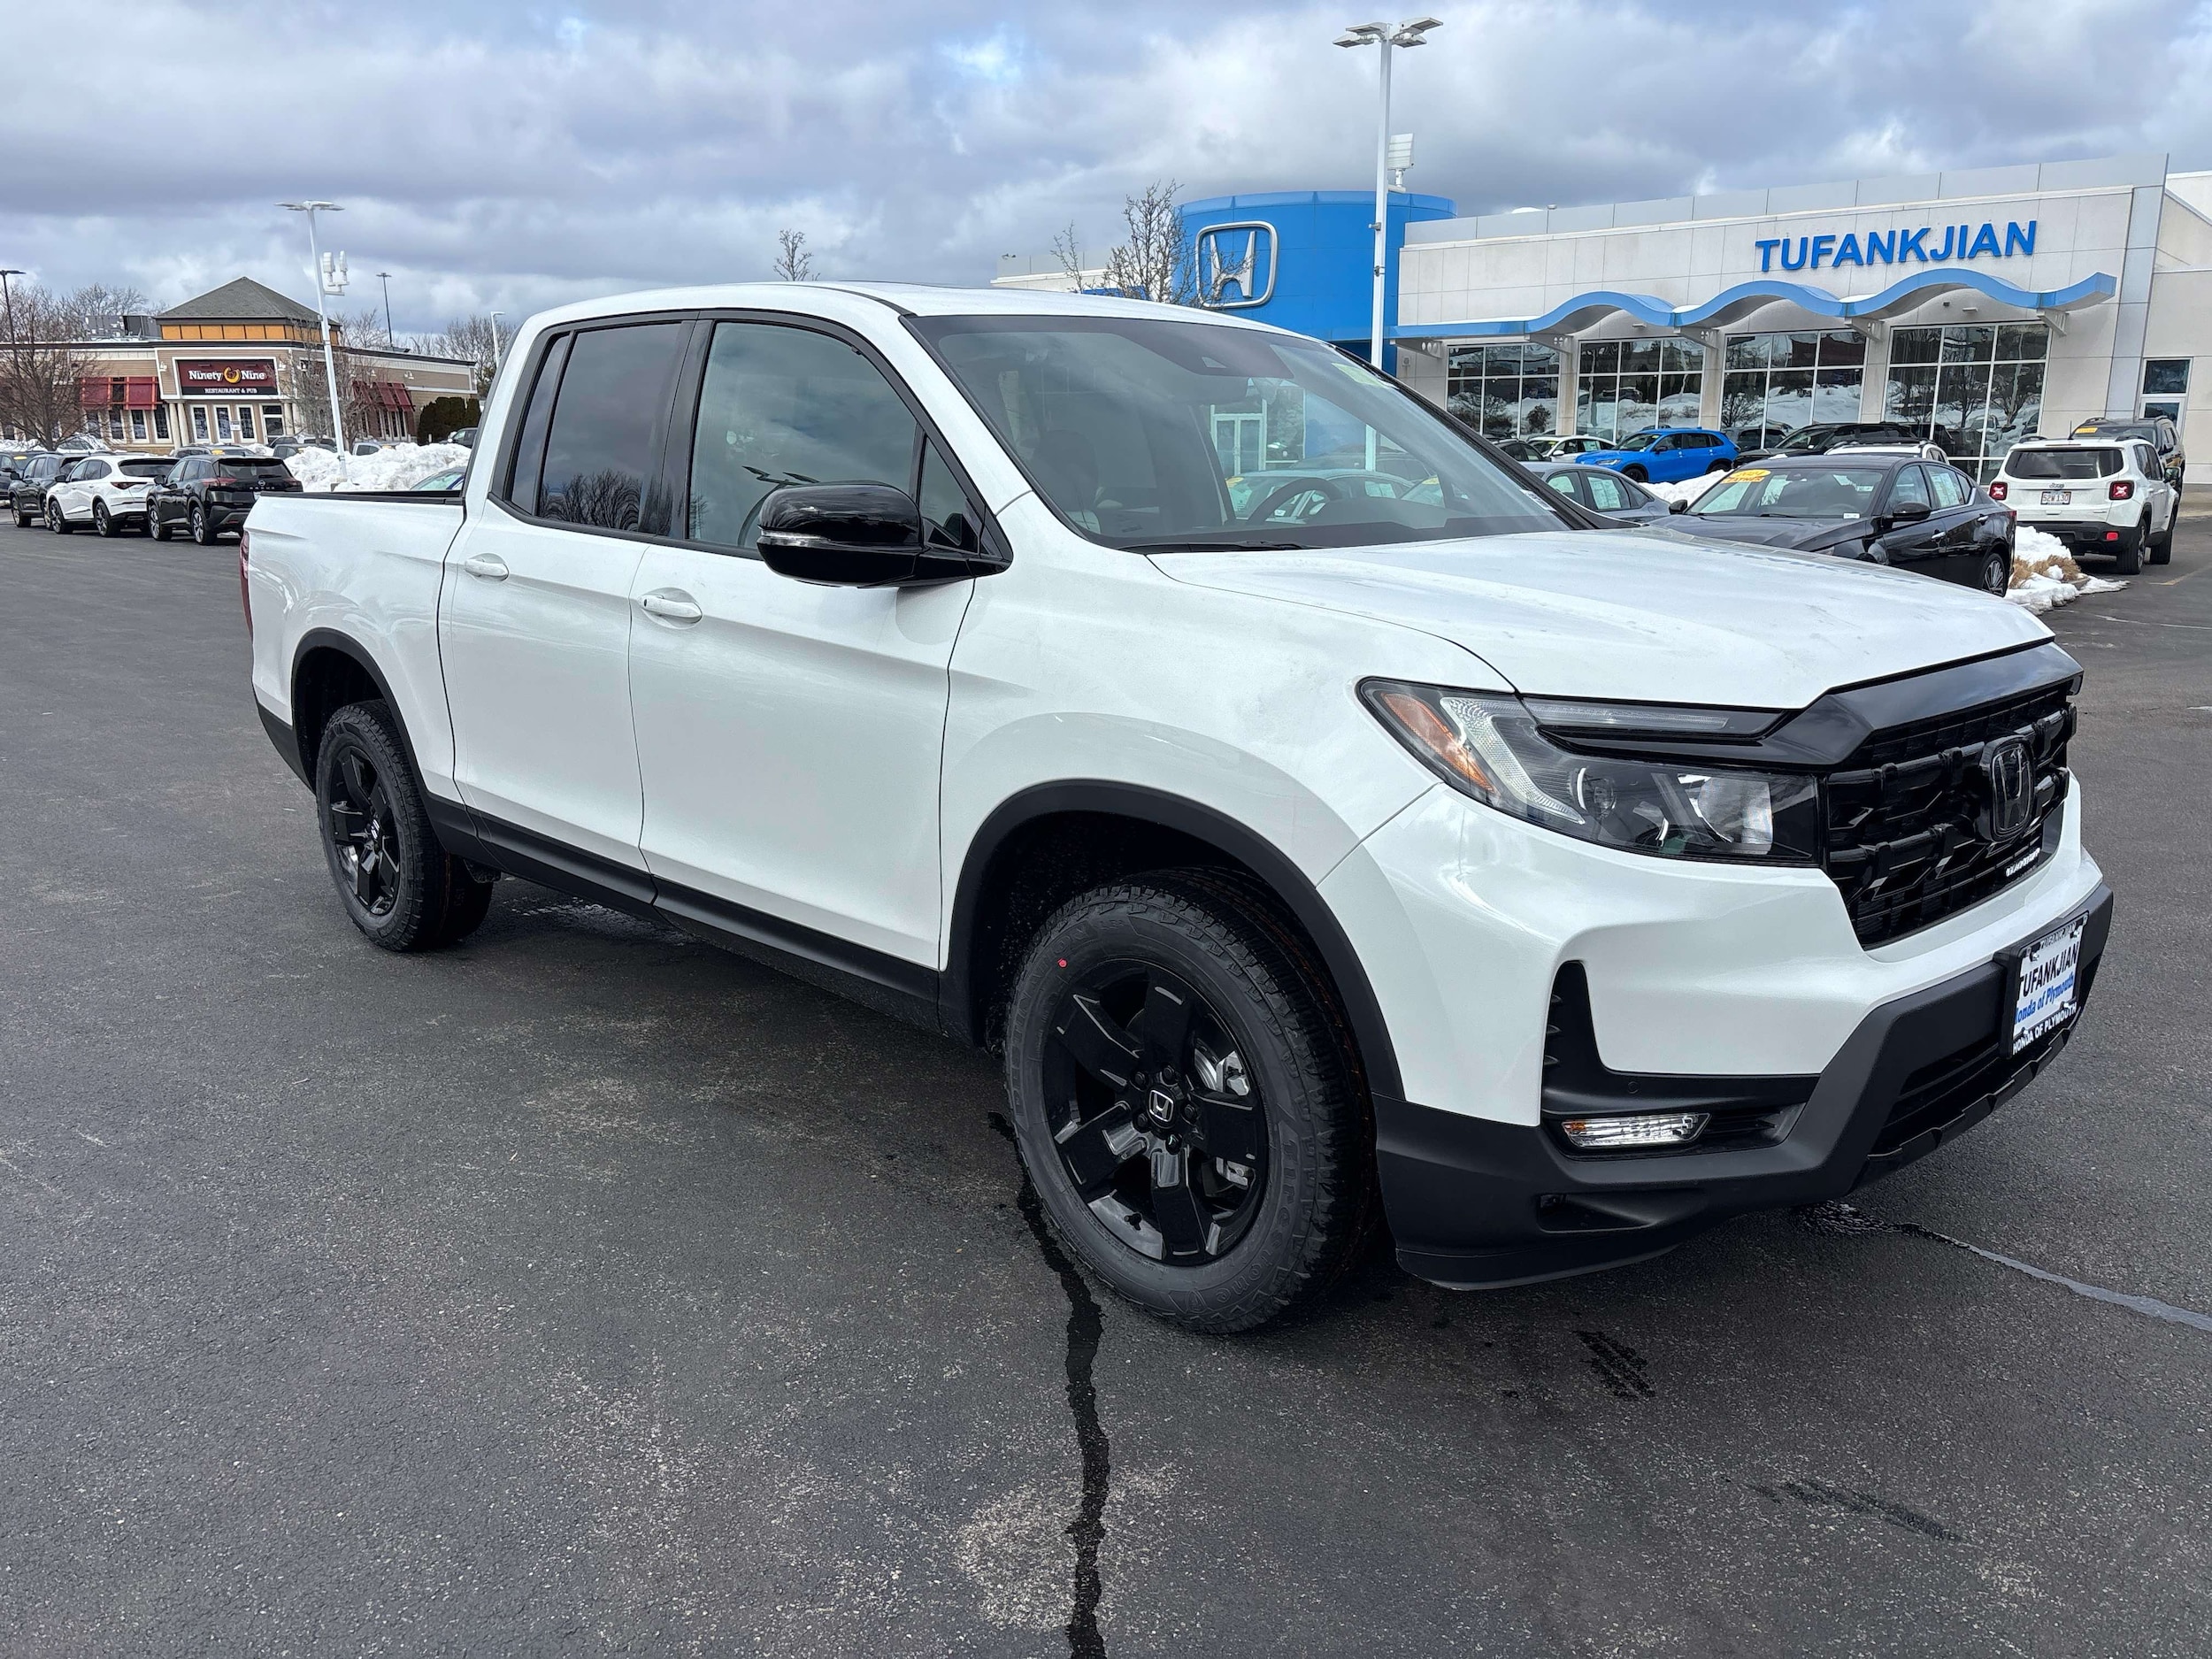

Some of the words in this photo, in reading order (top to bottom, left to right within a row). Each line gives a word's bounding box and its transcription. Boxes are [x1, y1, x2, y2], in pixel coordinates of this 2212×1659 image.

[1755, 219, 2037, 273] TUFANKJIAN
[188, 370, 223, 381] Ninety
[240, 370, 266, 380] Nine
[2037, 992, 2046, 1010] of
[2046, 972, 2074, 1005] Plymouth
[2012, 1030, 2034, 1056] HONDA
[2035, 1021, 2044, 1040] OF
[2044, 1001, 2078, 1033] PLYMOUTH
